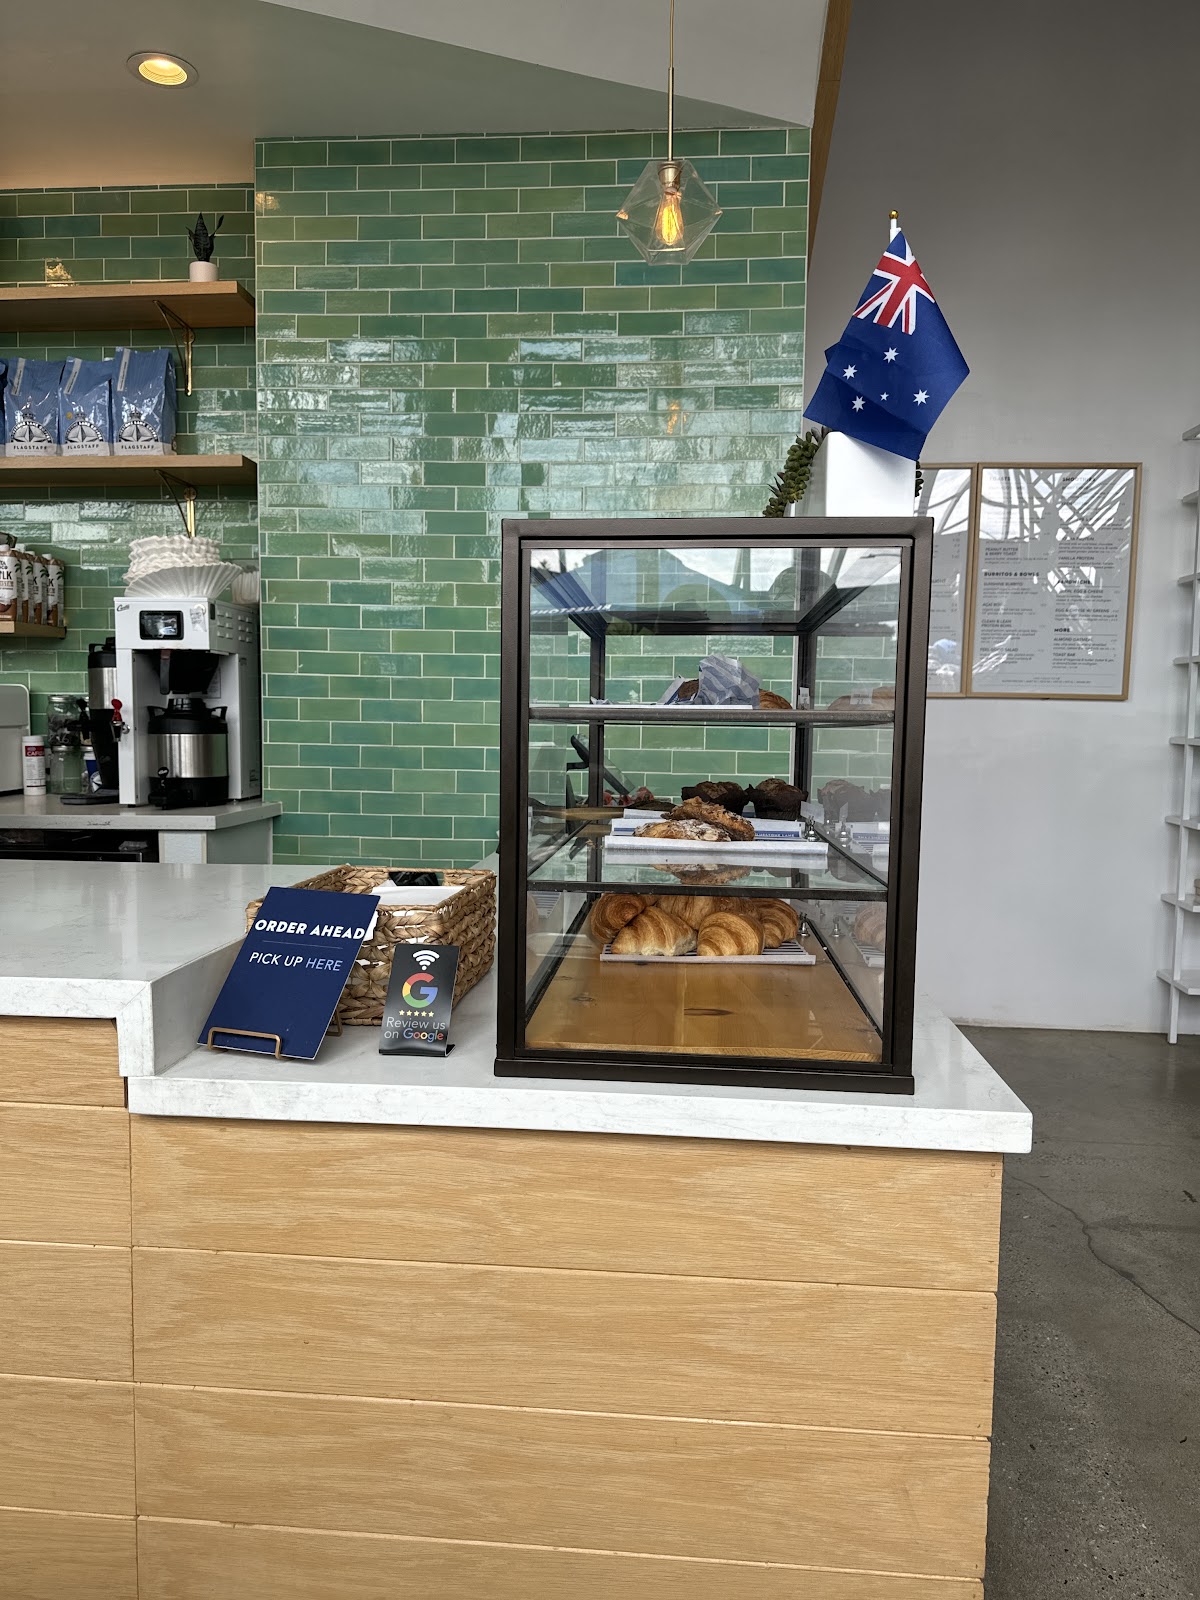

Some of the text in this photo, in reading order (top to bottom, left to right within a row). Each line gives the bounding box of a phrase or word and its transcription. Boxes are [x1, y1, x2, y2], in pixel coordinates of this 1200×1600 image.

[255, 920, 365, 940] ORDER AHEAD
[249, 952, 343, 971] PICK UP HERE
[386, 1017, 429, 1029] Review
[384, 1028, 444, 1042] on Google
